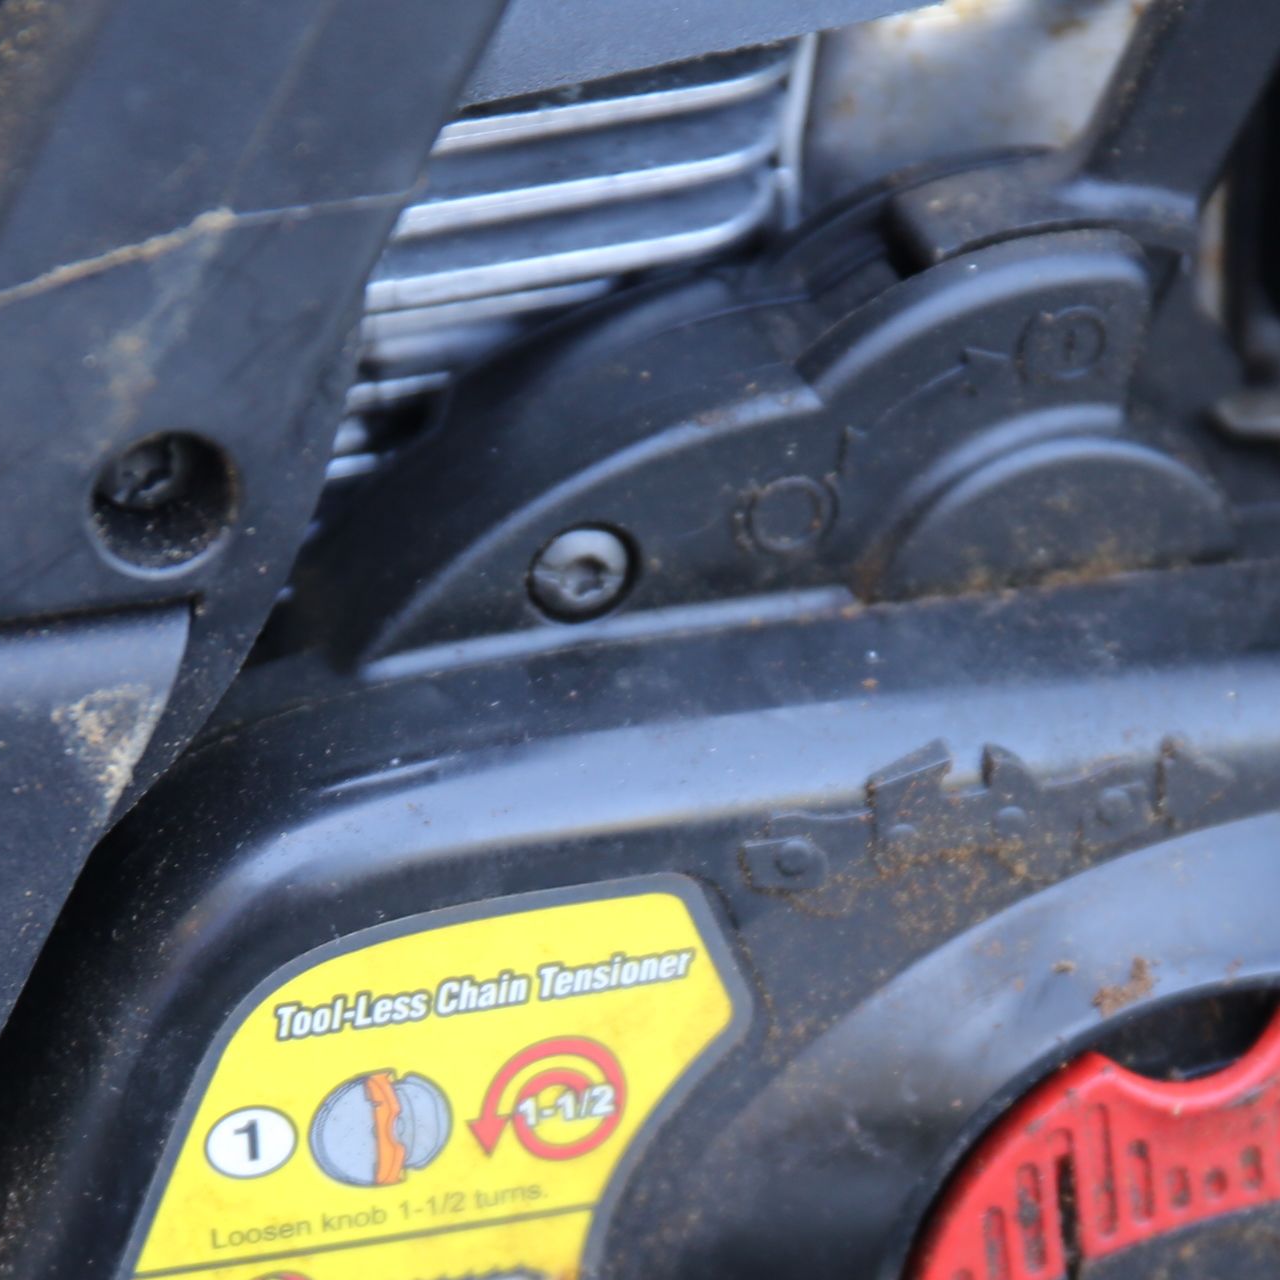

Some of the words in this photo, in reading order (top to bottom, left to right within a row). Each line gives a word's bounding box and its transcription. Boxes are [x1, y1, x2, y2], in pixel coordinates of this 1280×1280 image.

[276, 990, 427, 1042] Tool-Less
[435, 970, 530, 1017] Chain
[538, 947, 694, 1003] Tensioner
[519, 1083, 616, 1129] 1-1/2
[233, 1118, 261, 1162] 1
[210, 1217, 312, 1250] Loosen
[322, 1208, 388, 1235] knob
[399, 1190, 466, 1221] 1-1/2
[475, 1181, 549, 1211] turns.
